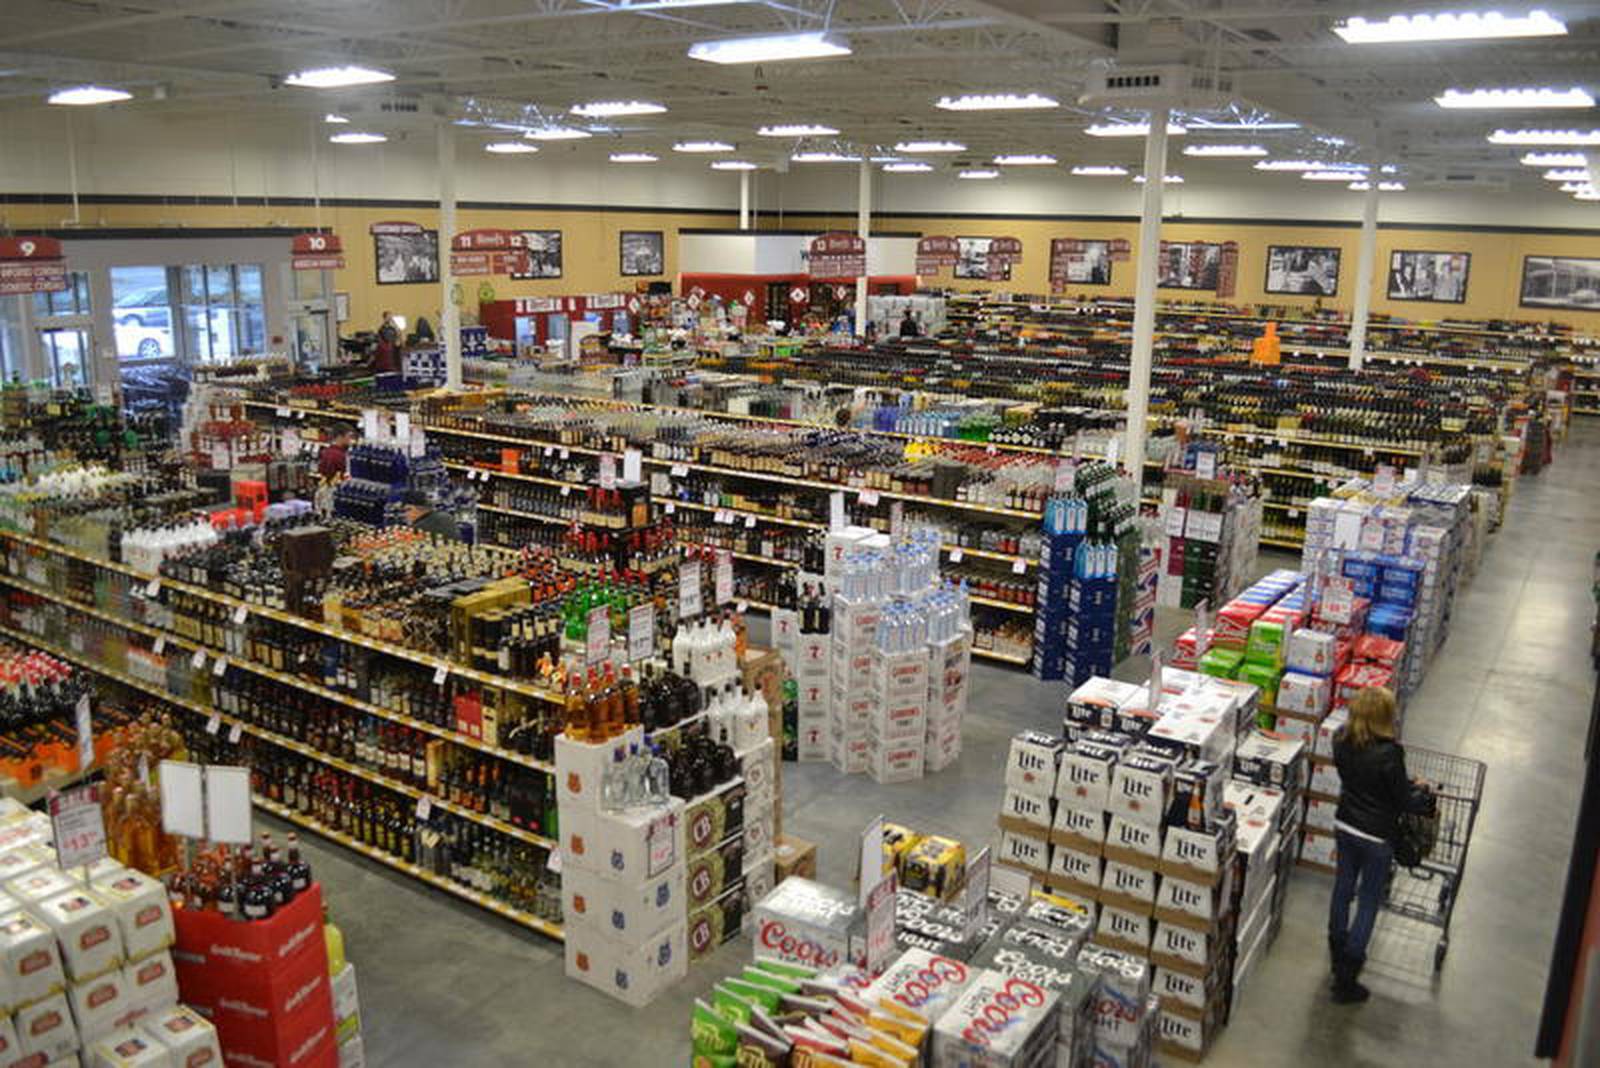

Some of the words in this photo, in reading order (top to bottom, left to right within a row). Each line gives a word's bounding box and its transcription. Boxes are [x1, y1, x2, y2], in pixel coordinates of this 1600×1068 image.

[20, 241, 36, 256] 9
[309, 237, 326, 250] 10
[1018, 752, 1045, 770] Lite
[1070, 765, 1099, 784] Lite
[1122, 777, 1152, 797] Lite
[1013, 792, 1042, 816] Lite
[1066, 805, 1094, 830] Lite
[1120, 820, 1150, 845] Lite
[1011, 836, 1040, 859] Lite
[1176, 834, 1206, 860] Lite
[1062, 850, 1092, 874] Lite
[1115, 864, 1145, 890] Lite
[1170, 880, 1202, 907] Lite
[1111, 910, 1140, 935] Lite
[761, 919, 839, 967] Coors
[898, 931, 944, 951] IGHT
[1166, 926, 1197, 952] Lite
[1165, 970, 1195, 995] Lite
[962, 978, 1044, 1046] Coors
[1160, 1013, 1192, 1039] Lite
